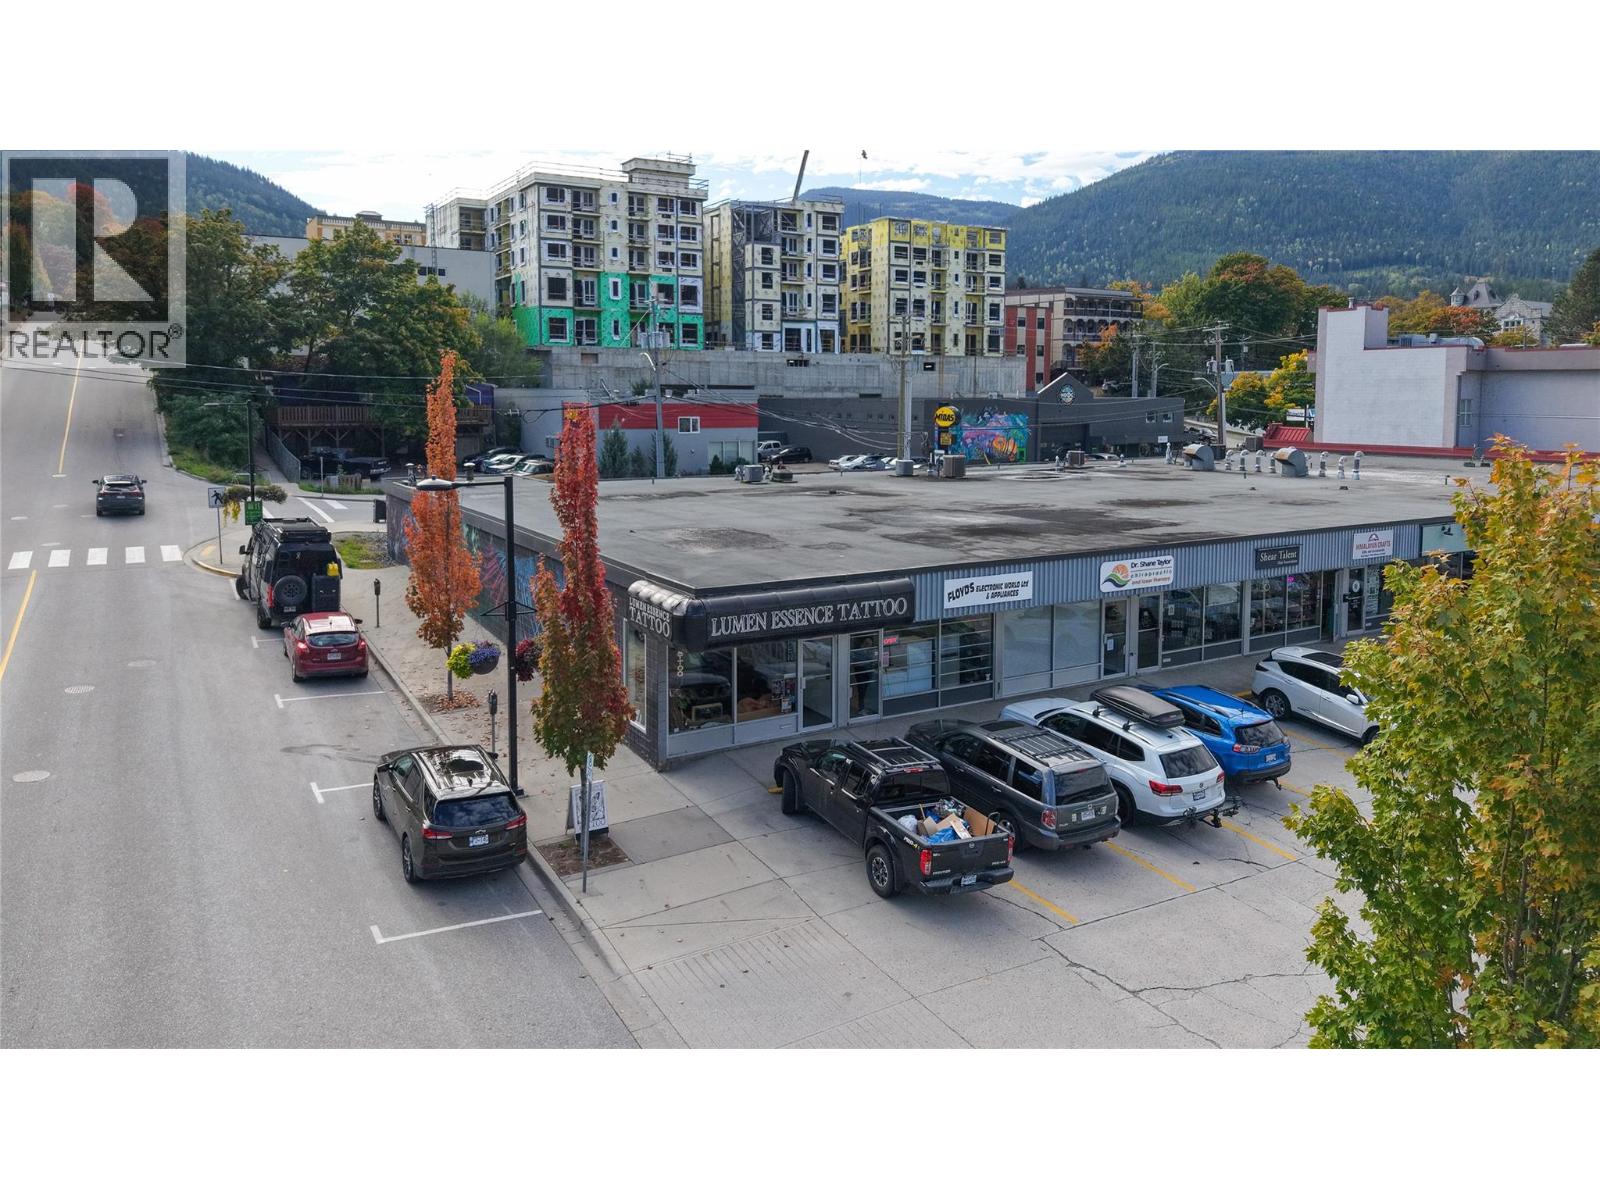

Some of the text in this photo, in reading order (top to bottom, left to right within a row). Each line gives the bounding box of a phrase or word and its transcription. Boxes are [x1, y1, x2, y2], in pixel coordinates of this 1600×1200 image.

[935, 413, 954, 422] MIDAS
[1260, 550, 1297, 562] Shear Talent
[1140, 560, 1156, 568] Shane
[976, 583, 1004, 592] ELECTRONIC
[1004, 581, 1021, 589] WORLD
[991, 589, 1020, 599] APPLIANCES
[629, 597, 671, 622] LUMEN ESSENCE
[630, 606, 670, 637] TATTOO
[711, 597, 907, 637] LUMEN ESSENCE TATTOO
